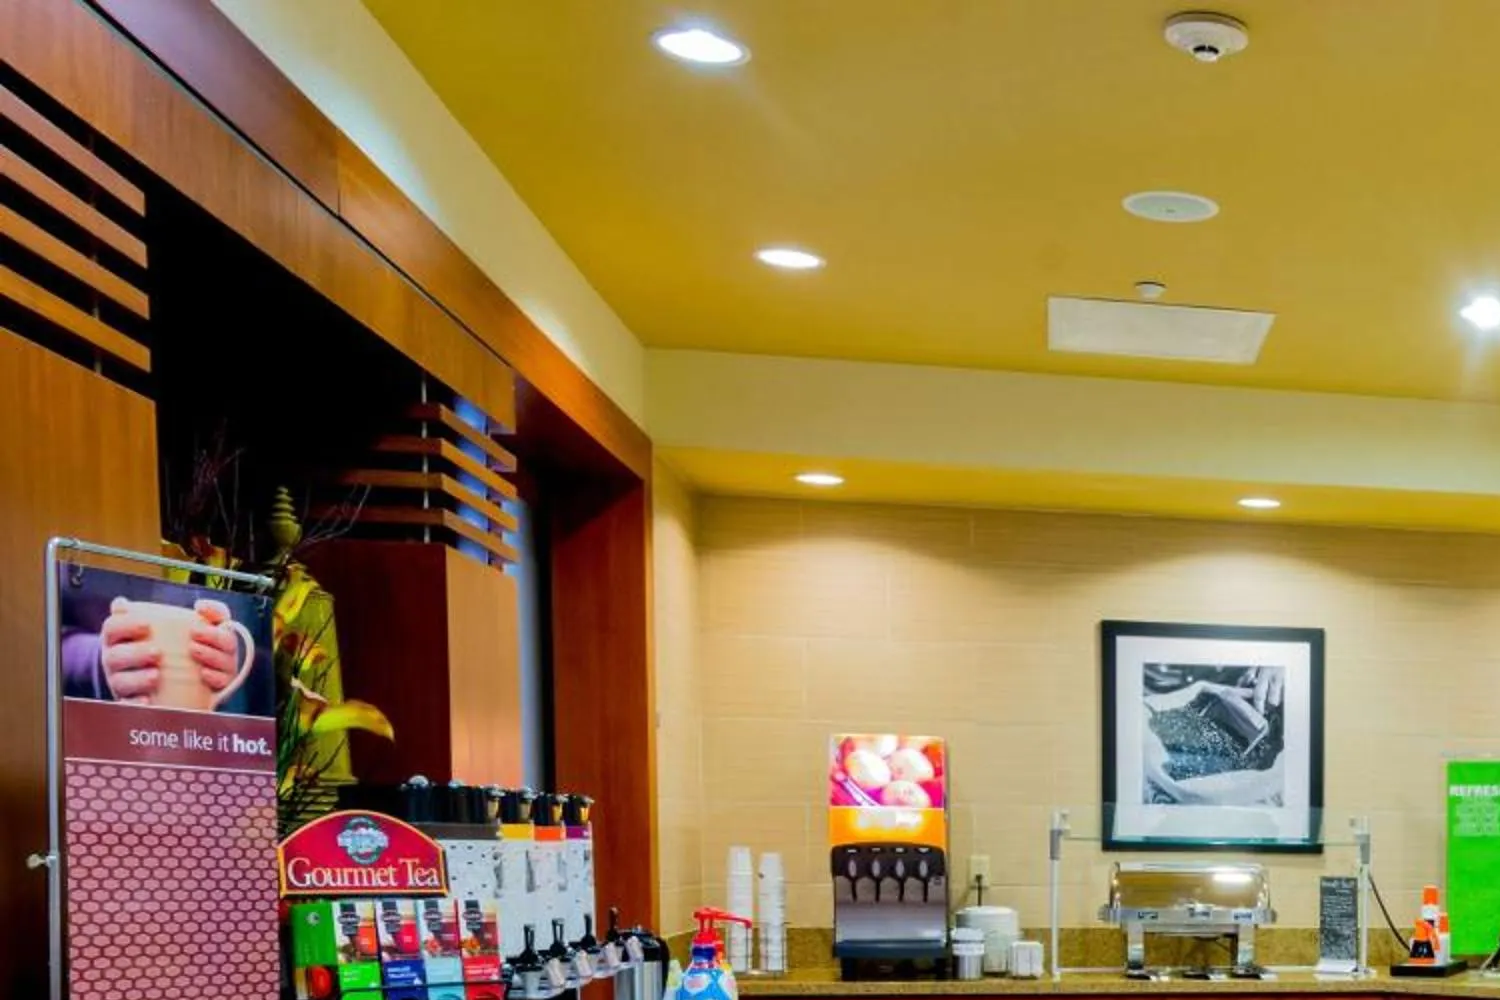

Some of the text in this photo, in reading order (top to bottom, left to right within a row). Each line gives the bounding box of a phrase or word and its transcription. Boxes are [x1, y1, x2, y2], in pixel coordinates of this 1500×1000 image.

[129, 728, 272, 755] some like it hot.
[287, 857, 440, 888] Gourmet Tea
